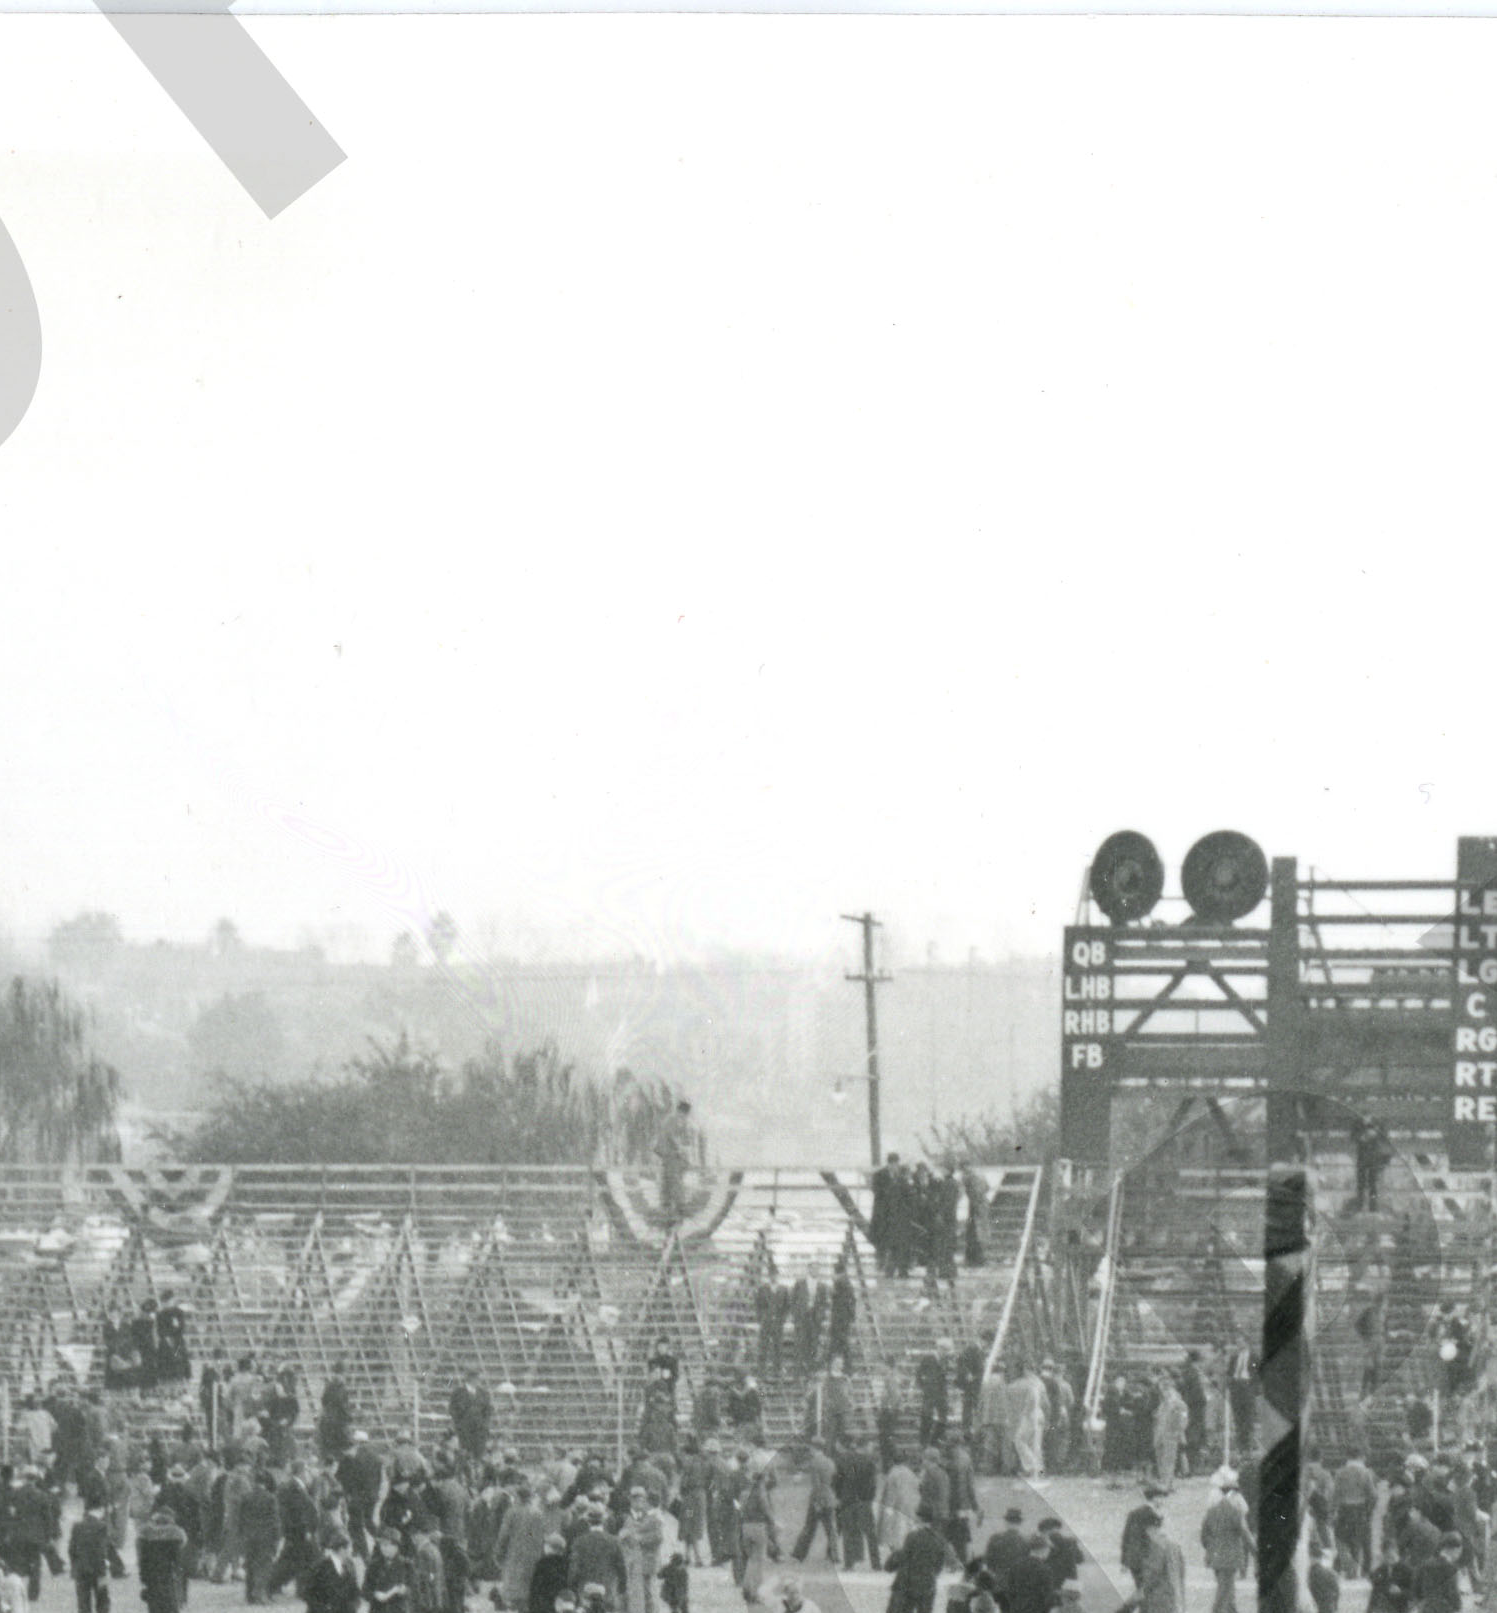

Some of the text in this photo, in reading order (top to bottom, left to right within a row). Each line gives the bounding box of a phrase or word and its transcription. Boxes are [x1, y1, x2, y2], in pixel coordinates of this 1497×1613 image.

[1072, 941, 1106, 968] QB
[1065, 975, 1111, 999] LHB
[1466, 992, 1487, 1018] C
[1065, 1009, 1110, 1034] RHB
[1072, 1043, 1103, 1068] FB
[1456, 1061, 1497, 1087] RT
[1455, 1096, 1497, 1121] RE
